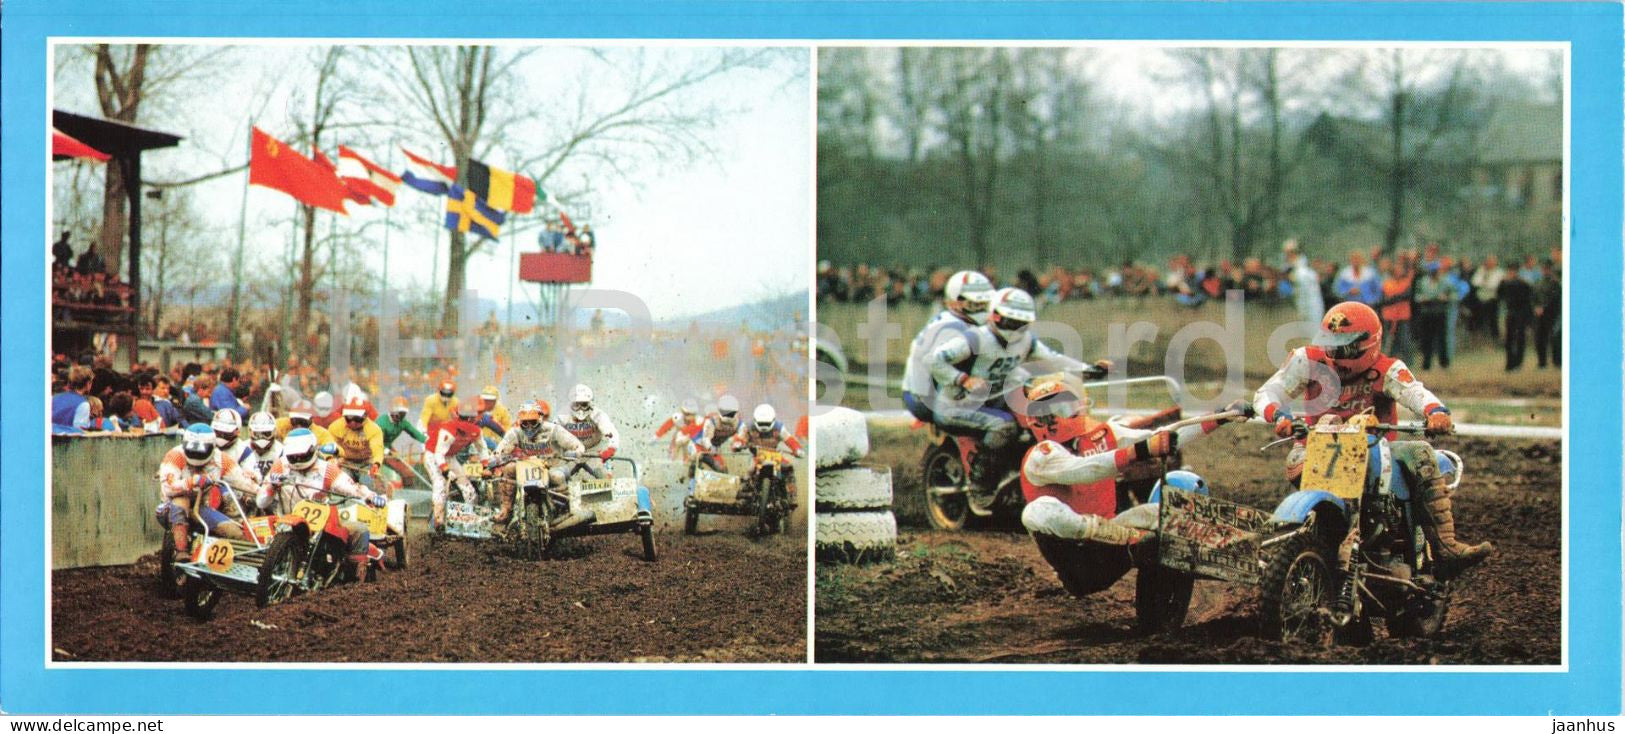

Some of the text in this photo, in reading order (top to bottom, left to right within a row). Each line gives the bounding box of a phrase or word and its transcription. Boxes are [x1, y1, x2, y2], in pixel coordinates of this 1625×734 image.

[1325, 442, 1343, 479] 7
[301, 506, 322, 525] 32
[208, 544, 228, 565] 32
